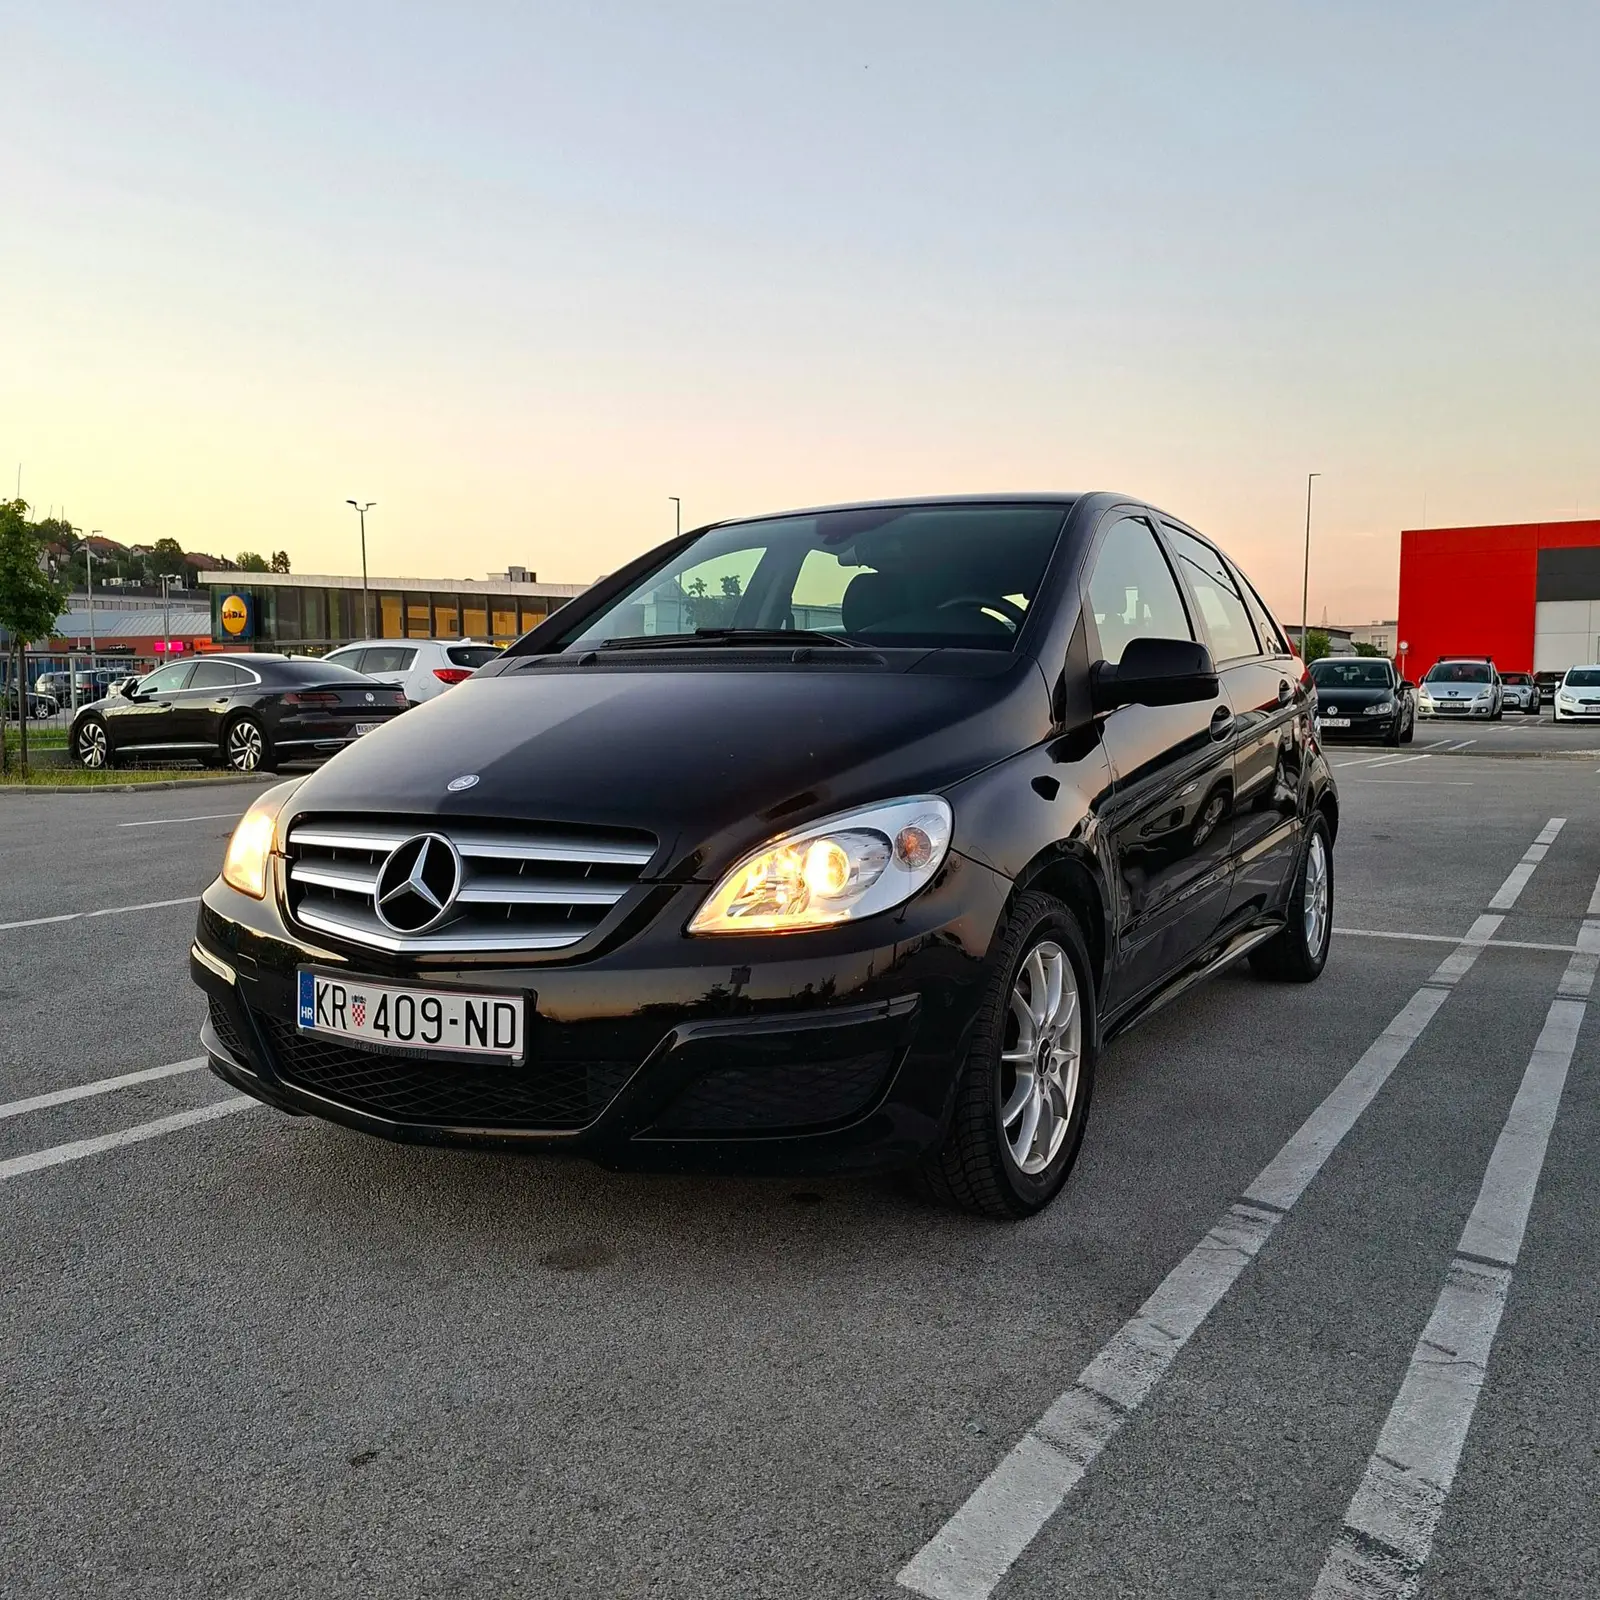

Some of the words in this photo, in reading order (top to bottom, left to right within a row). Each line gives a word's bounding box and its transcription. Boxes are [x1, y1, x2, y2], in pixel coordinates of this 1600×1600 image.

[301, 1005, 313, 1020] HR
[316, 981, 347, 1030] KR
[373, 993, 516, 1049] 409-ND
